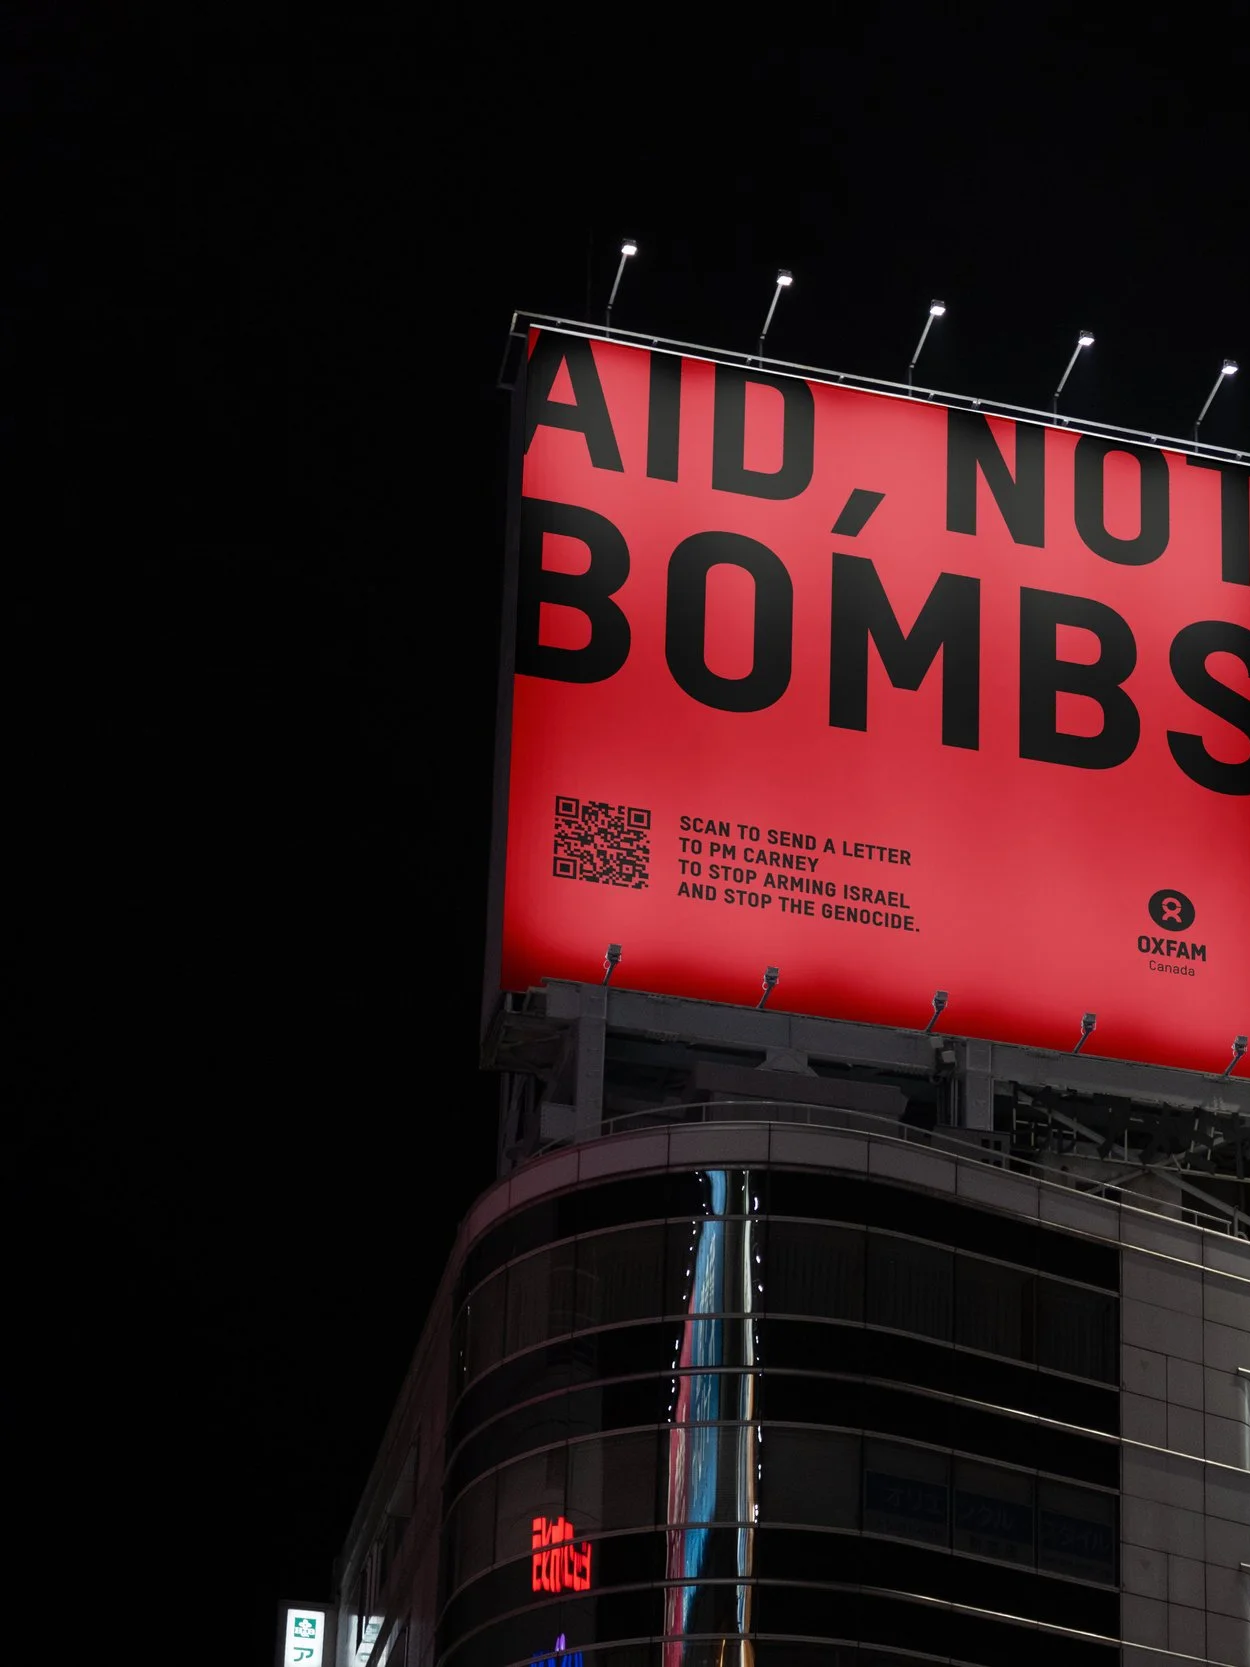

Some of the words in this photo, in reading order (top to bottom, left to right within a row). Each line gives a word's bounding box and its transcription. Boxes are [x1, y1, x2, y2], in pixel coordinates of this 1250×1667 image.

[525, 328, 886, 538] AID,
[679, 836, 702, 855] TO
[709, 842, 736, 860] PM
[743, 847, 819, 872] CARNEY
[680, 815, 730, 837] SCAN
[737, 824, 760, 842] TO
[767, 829, 817, 850] SEND
[823, 838, 836, 854] A
[843, 840, 911, 866] LETTER
[677, 881, 717, 901] AND
[724, 888, 772, 909] STOP
[778, 896, 815, 916] THE
[822, 903, 920, 932] GENOCIDE.
[678, 858, 701, 877] TO
[709, 864, 757, 884] STOP
[763, 872, 836, 898] ARMING
[843, 884, 911, 909] ISRAEL
[1137, 935, 1207, 962] OXFAM
[1149, 960, 1196, 976] Canada
